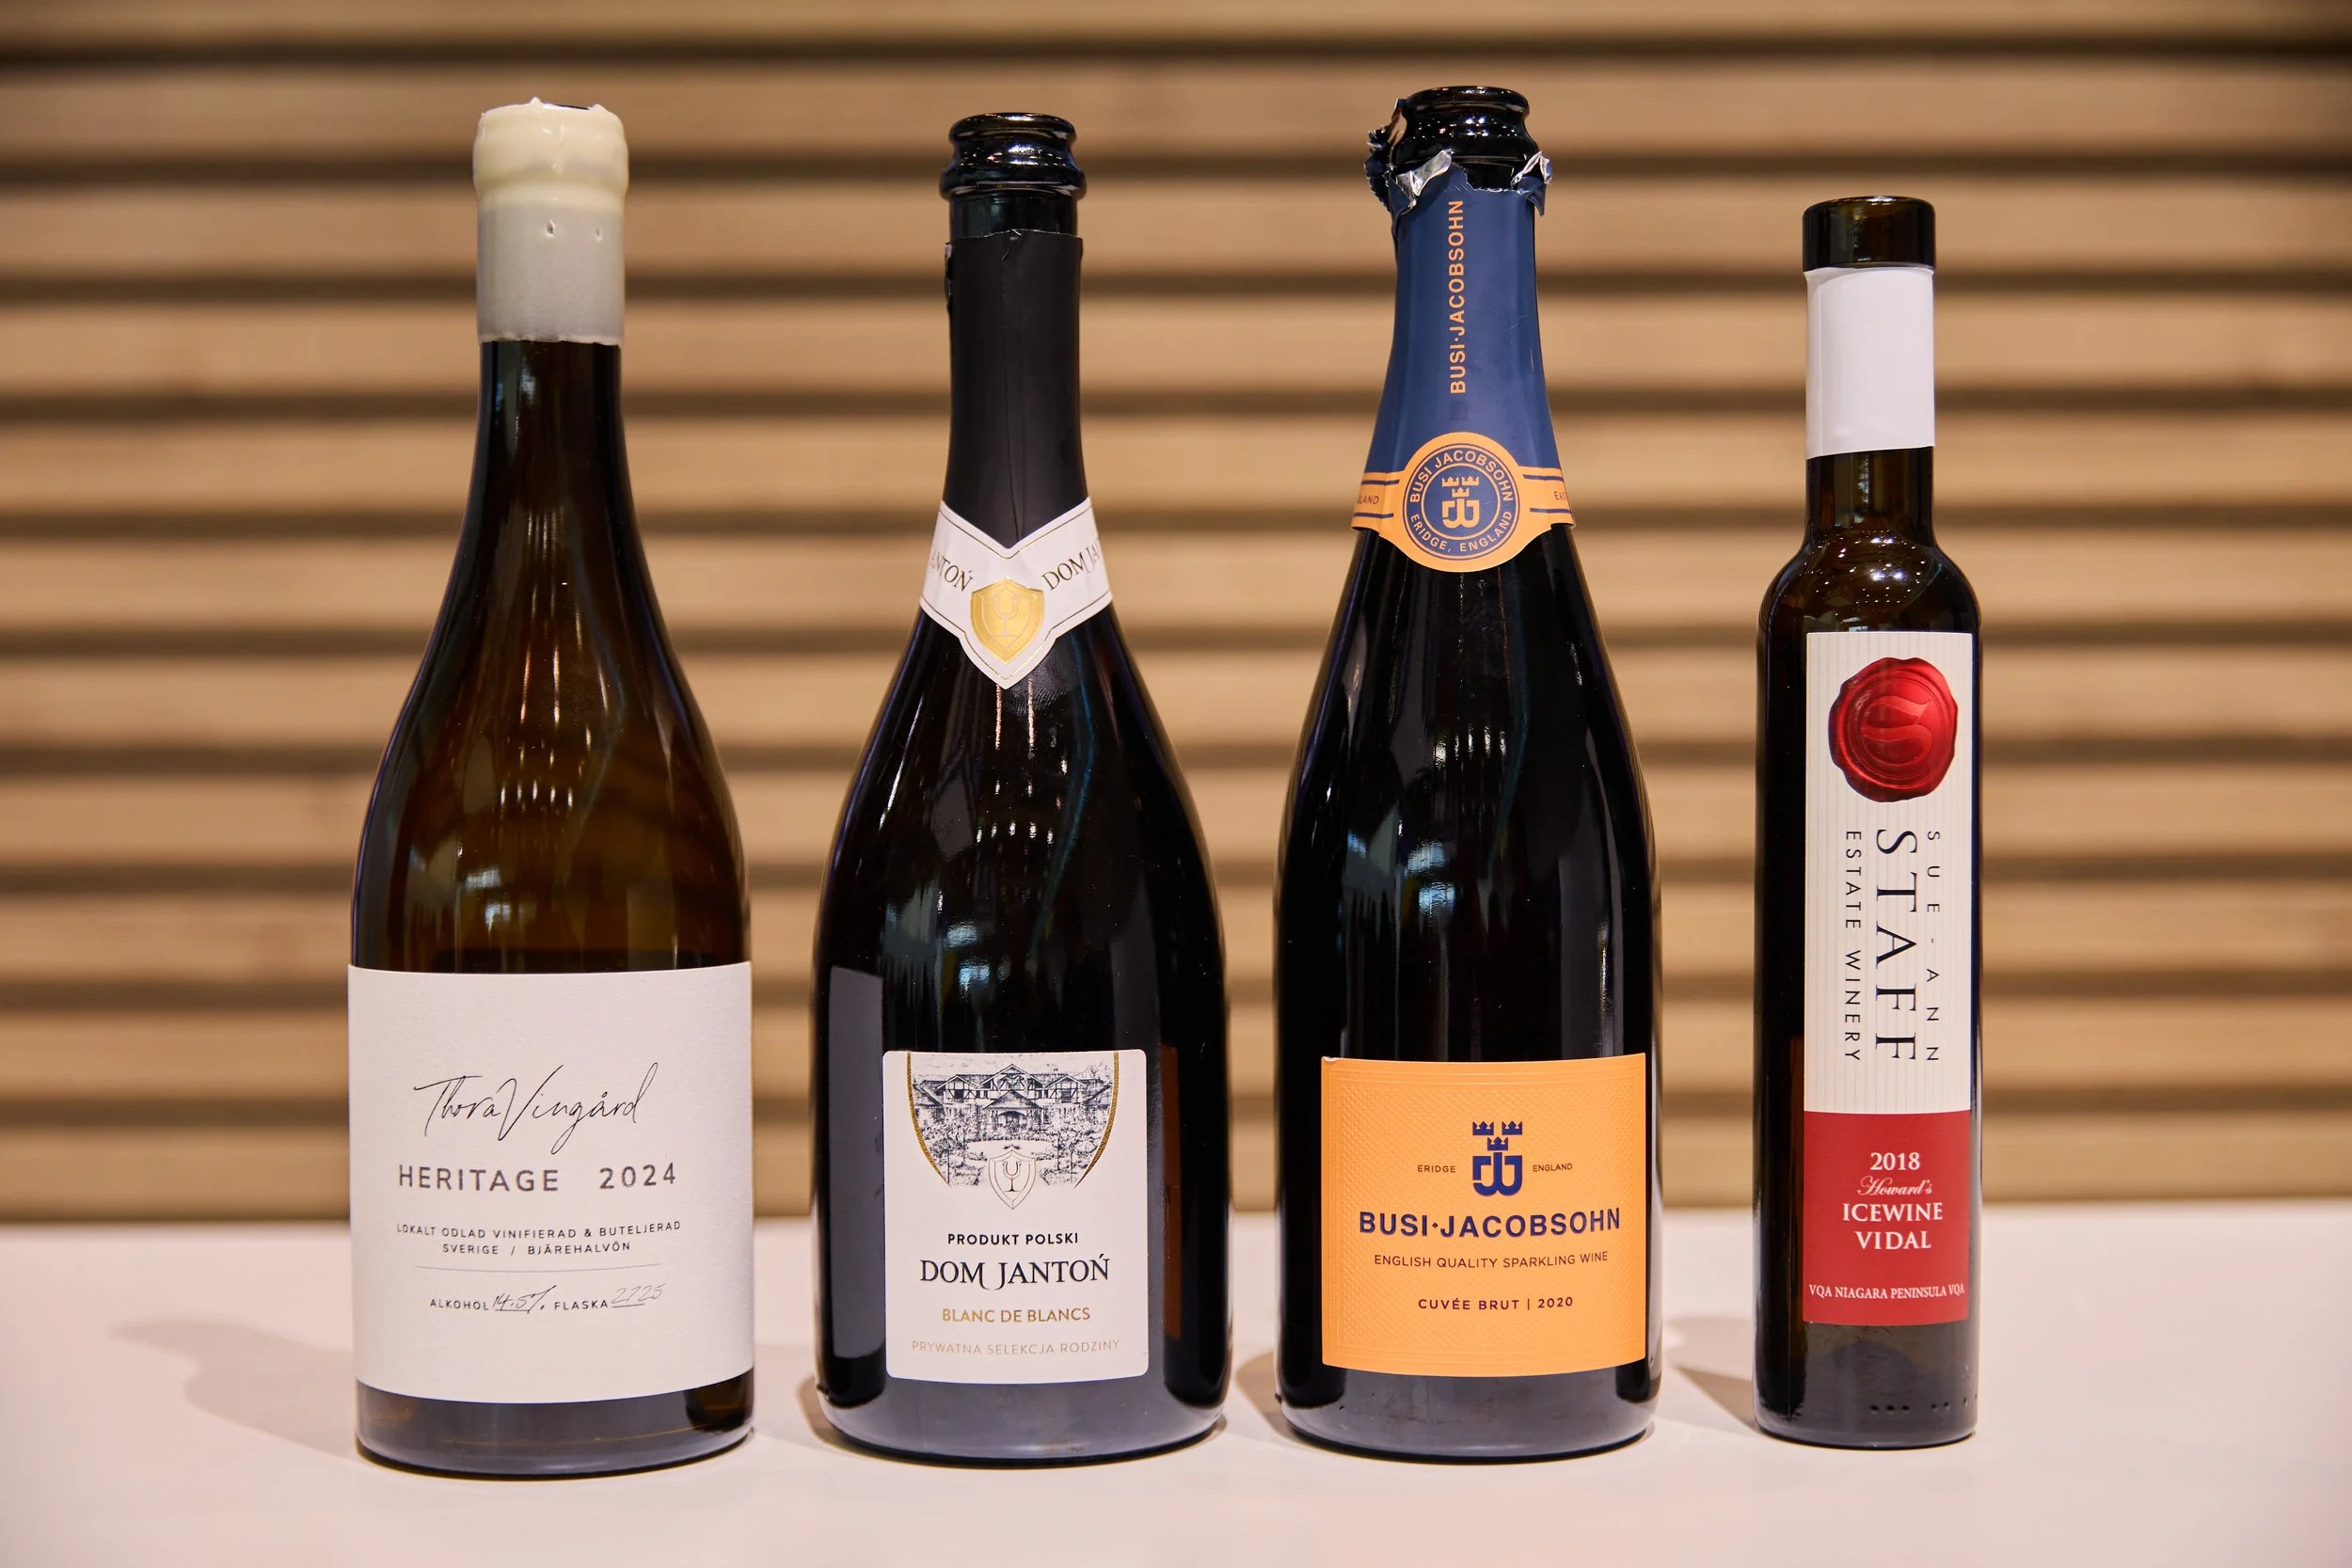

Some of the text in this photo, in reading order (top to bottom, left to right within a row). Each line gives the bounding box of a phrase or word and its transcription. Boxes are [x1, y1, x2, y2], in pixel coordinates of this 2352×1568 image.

[1409, 467, 1433, 503] BUSI
[1459, 510, 1513, 552] ENGLAND
[1845, 831, 1862, 1061] ESTATE WINERY
[1875, 829, 1917, 1061] STAFF
[1417, 1163, 1573, 1173] ERIDGE ENGLAND
[1870, 1152, 1920, 1171] 2018
[399, 1163, 676, 1192] HERITAGE 2024
[1842, 1202, 1943, 1222] ICEWINE
[396, 1221, 681, 1239] LOKALT ODLAD VINIFIERAD & BUTELJERAD
[947, 1232, 1079, 1245] PRODUKT POLSKI
[442, 1243, 499, 1255] SVERIGE
[1855, 1230, 1931, 1250] VIDAL
[1375, 1251, 1609, 1268] ENGLISH QUALITY SPARKLING WINE
[920, 1253, 1110, 1291] DOM JANTOŃ
[1809, 1283, 1964, 1299] VQA NIAGARA PENINSULA VQA
[430, 1298, 489, 1311] ALKOHOL
[554, 1300, 609, 1311] FLASKA
[1418, 1297, 1470, 1310] CUVÉE
[1478, 1299, 1518, 1310] BRUT
[1537, 1296, 1573, 1308] 2020
[942, 1307, 1090, 1323] BLANC DE BLANCS
[912, 1339, 1120, 1354] PRYWATNA SELEKCJA RODZINY
